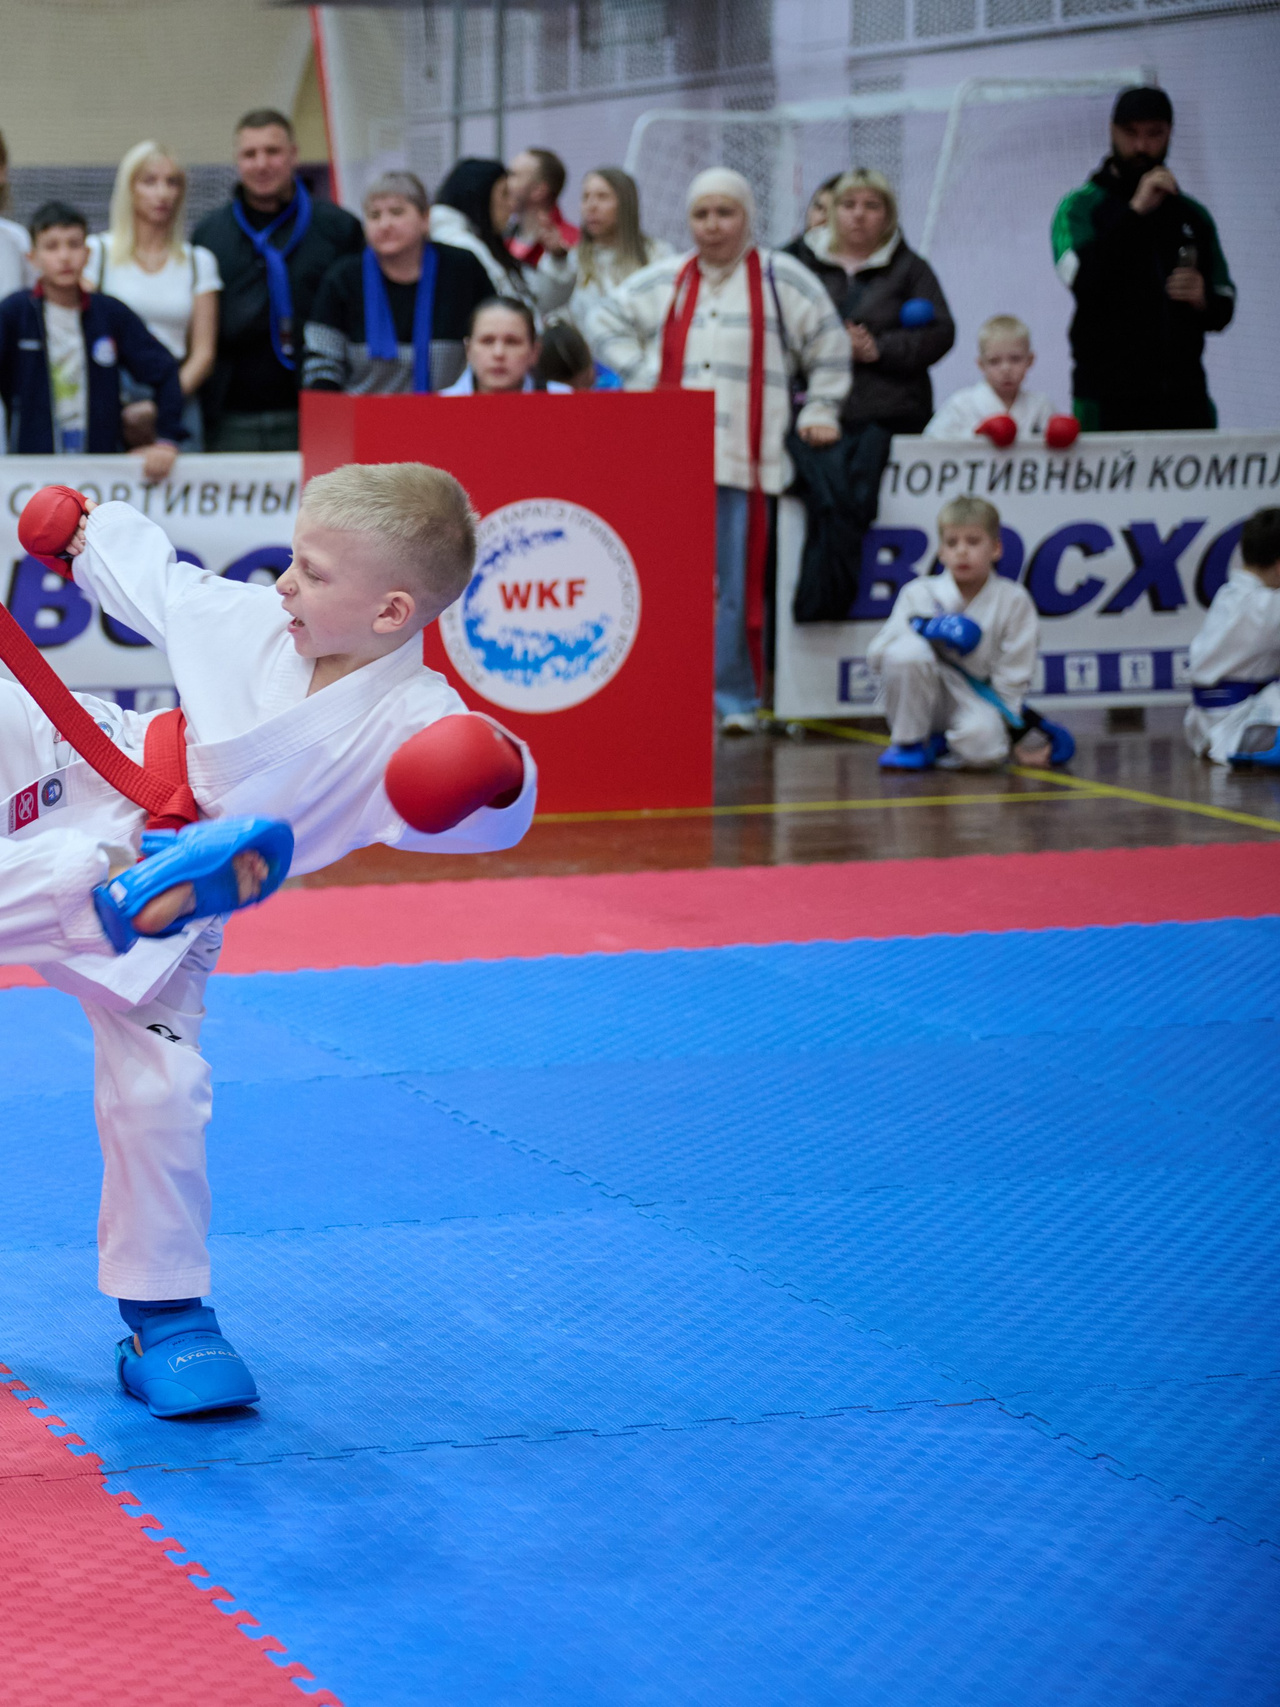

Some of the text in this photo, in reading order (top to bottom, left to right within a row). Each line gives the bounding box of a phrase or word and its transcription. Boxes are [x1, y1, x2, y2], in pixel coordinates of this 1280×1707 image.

[885, 449, 1137, 495] ПОРТИВНЫЙ
[9, 480, 299, 518] СОРТИВНЫ
[500, 577, 586, 610] WKF
